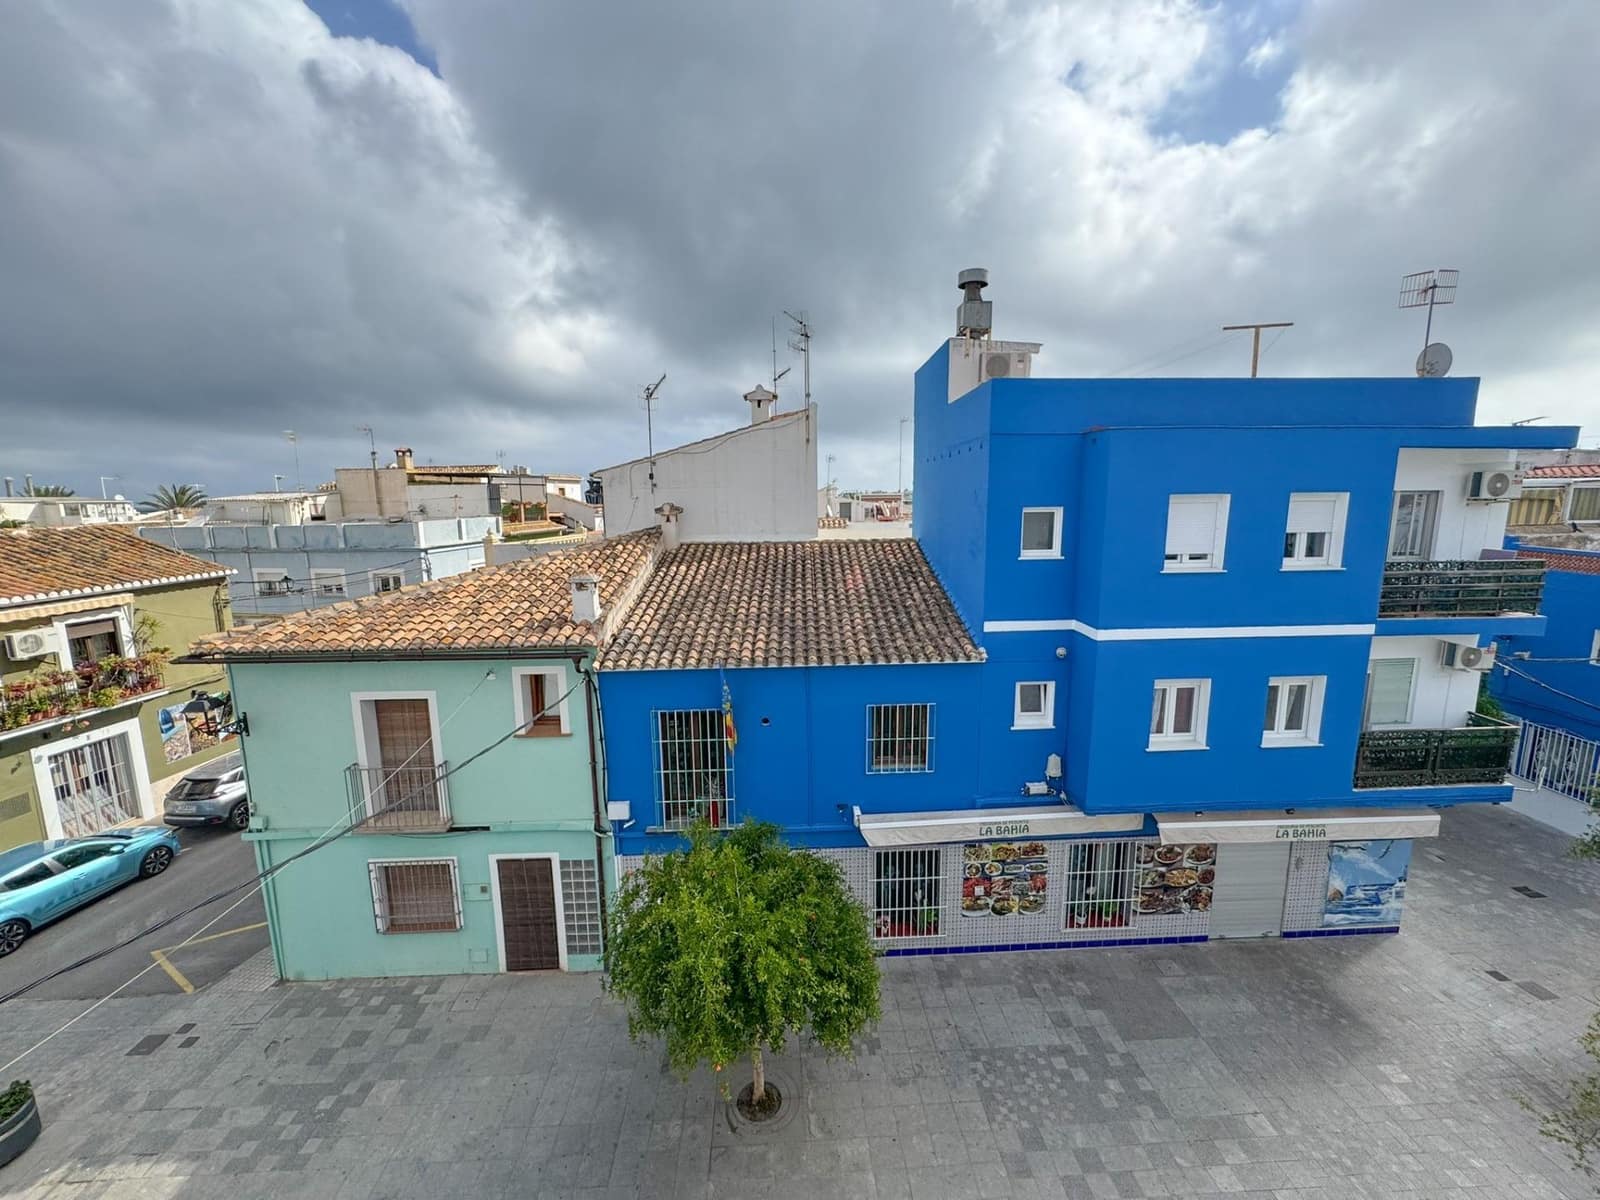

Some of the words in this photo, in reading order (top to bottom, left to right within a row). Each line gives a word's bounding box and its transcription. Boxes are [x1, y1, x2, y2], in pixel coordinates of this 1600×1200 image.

[979, 826, 993, 836] LA
[996, 824, 1030, 835] BAHIA
[1276, 829, 1289, 838] LA
[1292, 828, 1326, 838] BAHIA
